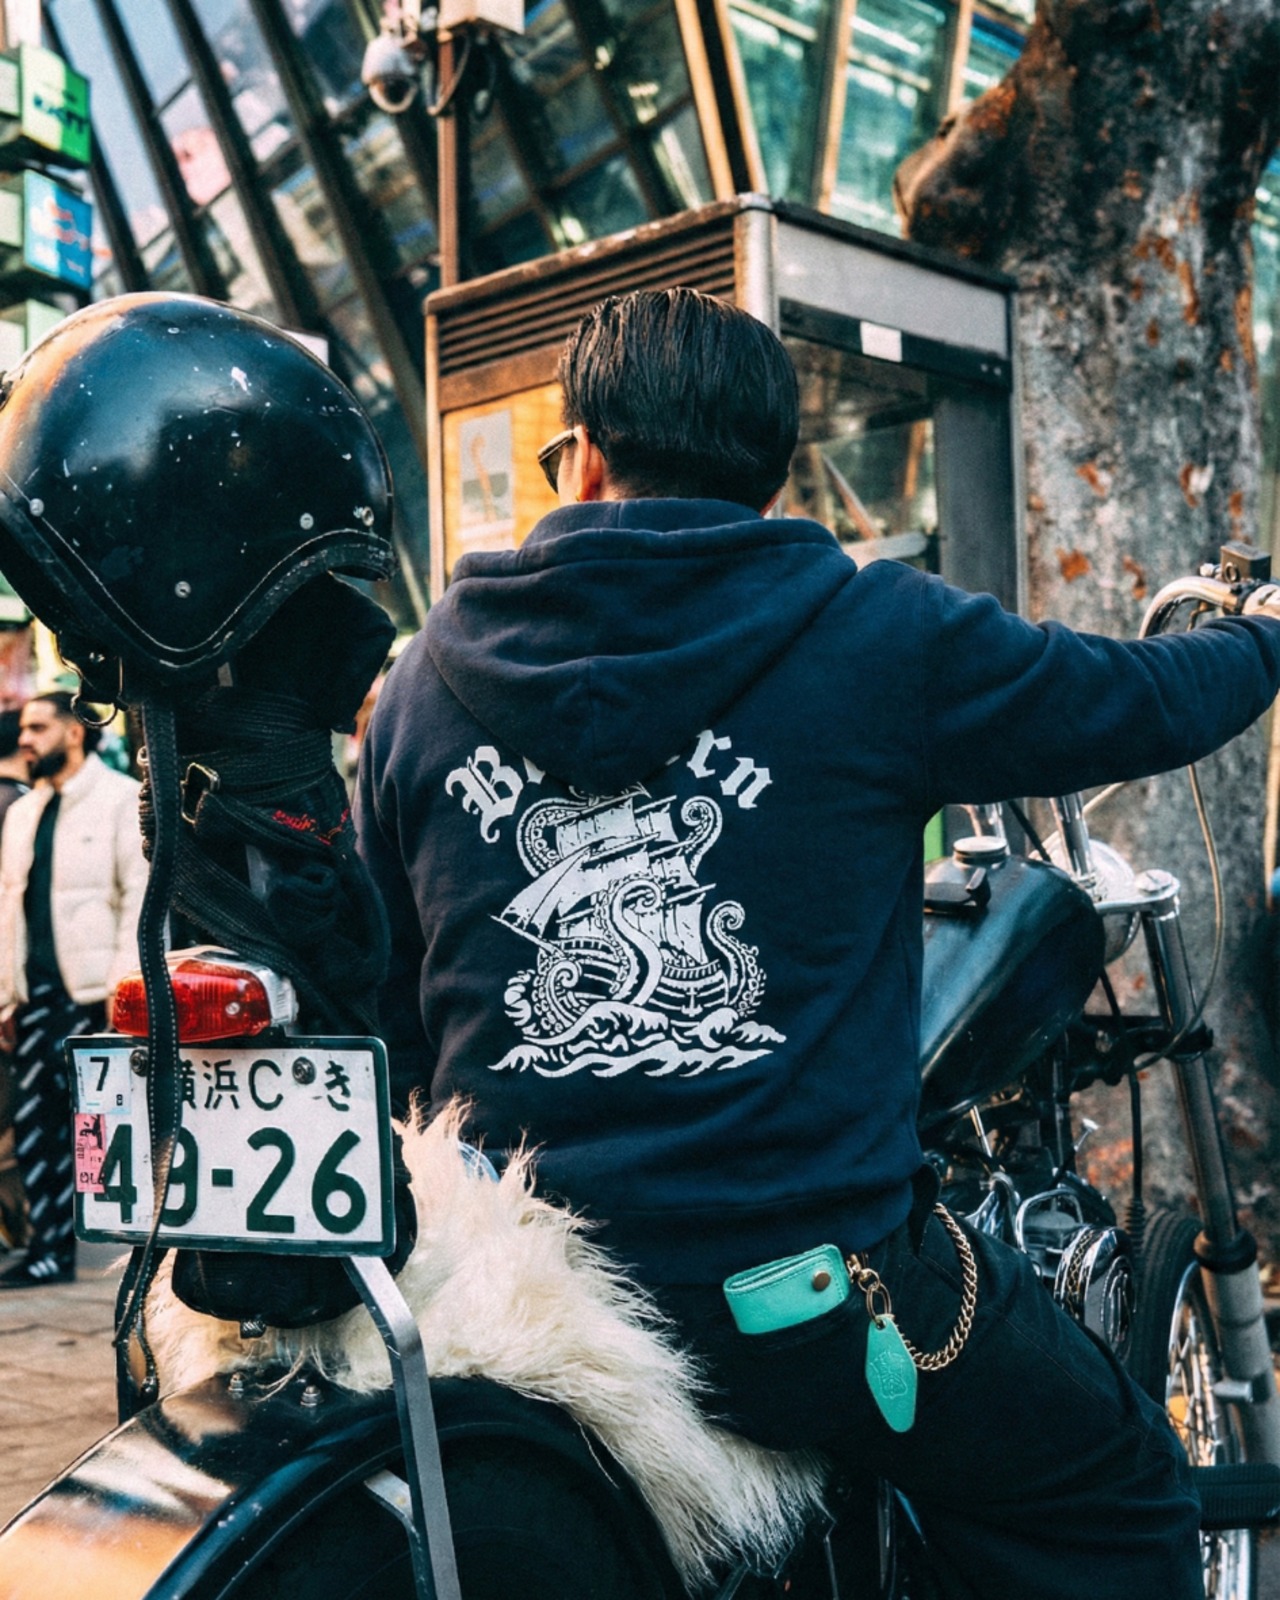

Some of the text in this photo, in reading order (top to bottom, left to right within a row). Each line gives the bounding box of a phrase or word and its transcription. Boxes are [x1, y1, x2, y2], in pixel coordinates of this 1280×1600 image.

[90, 1056, 110, 1091] 7
[325, 1060, 350, 1112] き
[95, 1124, 367, 1234] 49-26
